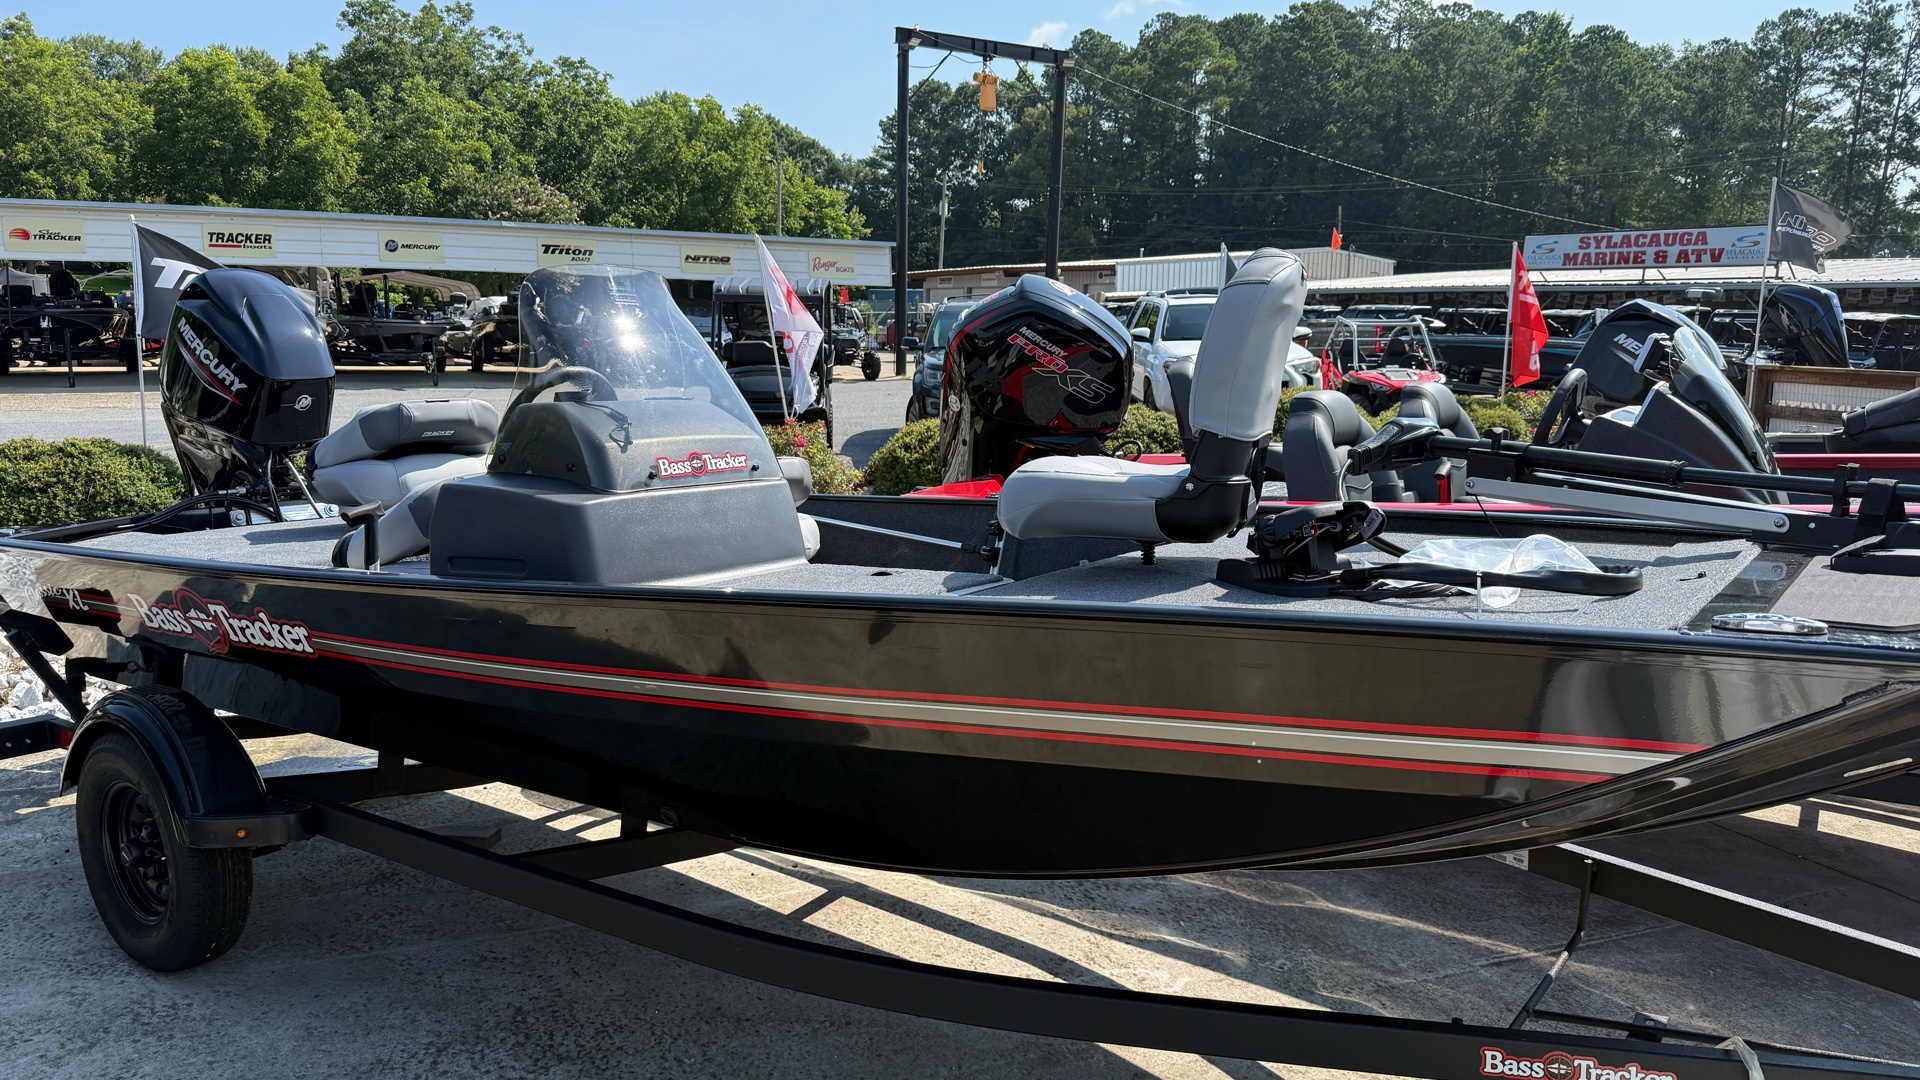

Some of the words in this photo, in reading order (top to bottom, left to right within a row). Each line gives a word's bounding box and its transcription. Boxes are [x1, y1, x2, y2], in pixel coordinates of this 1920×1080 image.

[207, 232, 273, 245] TRACKER
[400, 243, 441, 251] MERCURY
[1578, 230, 1709, 250] SYLACAUGA
[541, 244, 594, 257] Triton
[684, 254, 731, 263] NITRO
[1561, 250, 1646, 267] MARINE
[1652, 249, 1669, 265] &
[1674, 247, 1726, 264] ATV
[1725, 248, 1765, 256] SYLACAUG
[812, 256, 838, 272] Ranger
[1019, 326, 1069, 358] MERCURY
[177, 317, 248, 393] MERCURY
[1007, 333, 1069, 373] PRO
[657, 459, 691, 475] Bass
[702, 453, 747, 471] Tracker
[127, 593, 193, 634] Bass
[207, 603, 314, 653] Tracker
[1483, 1050, 1544, 1078] Bass
